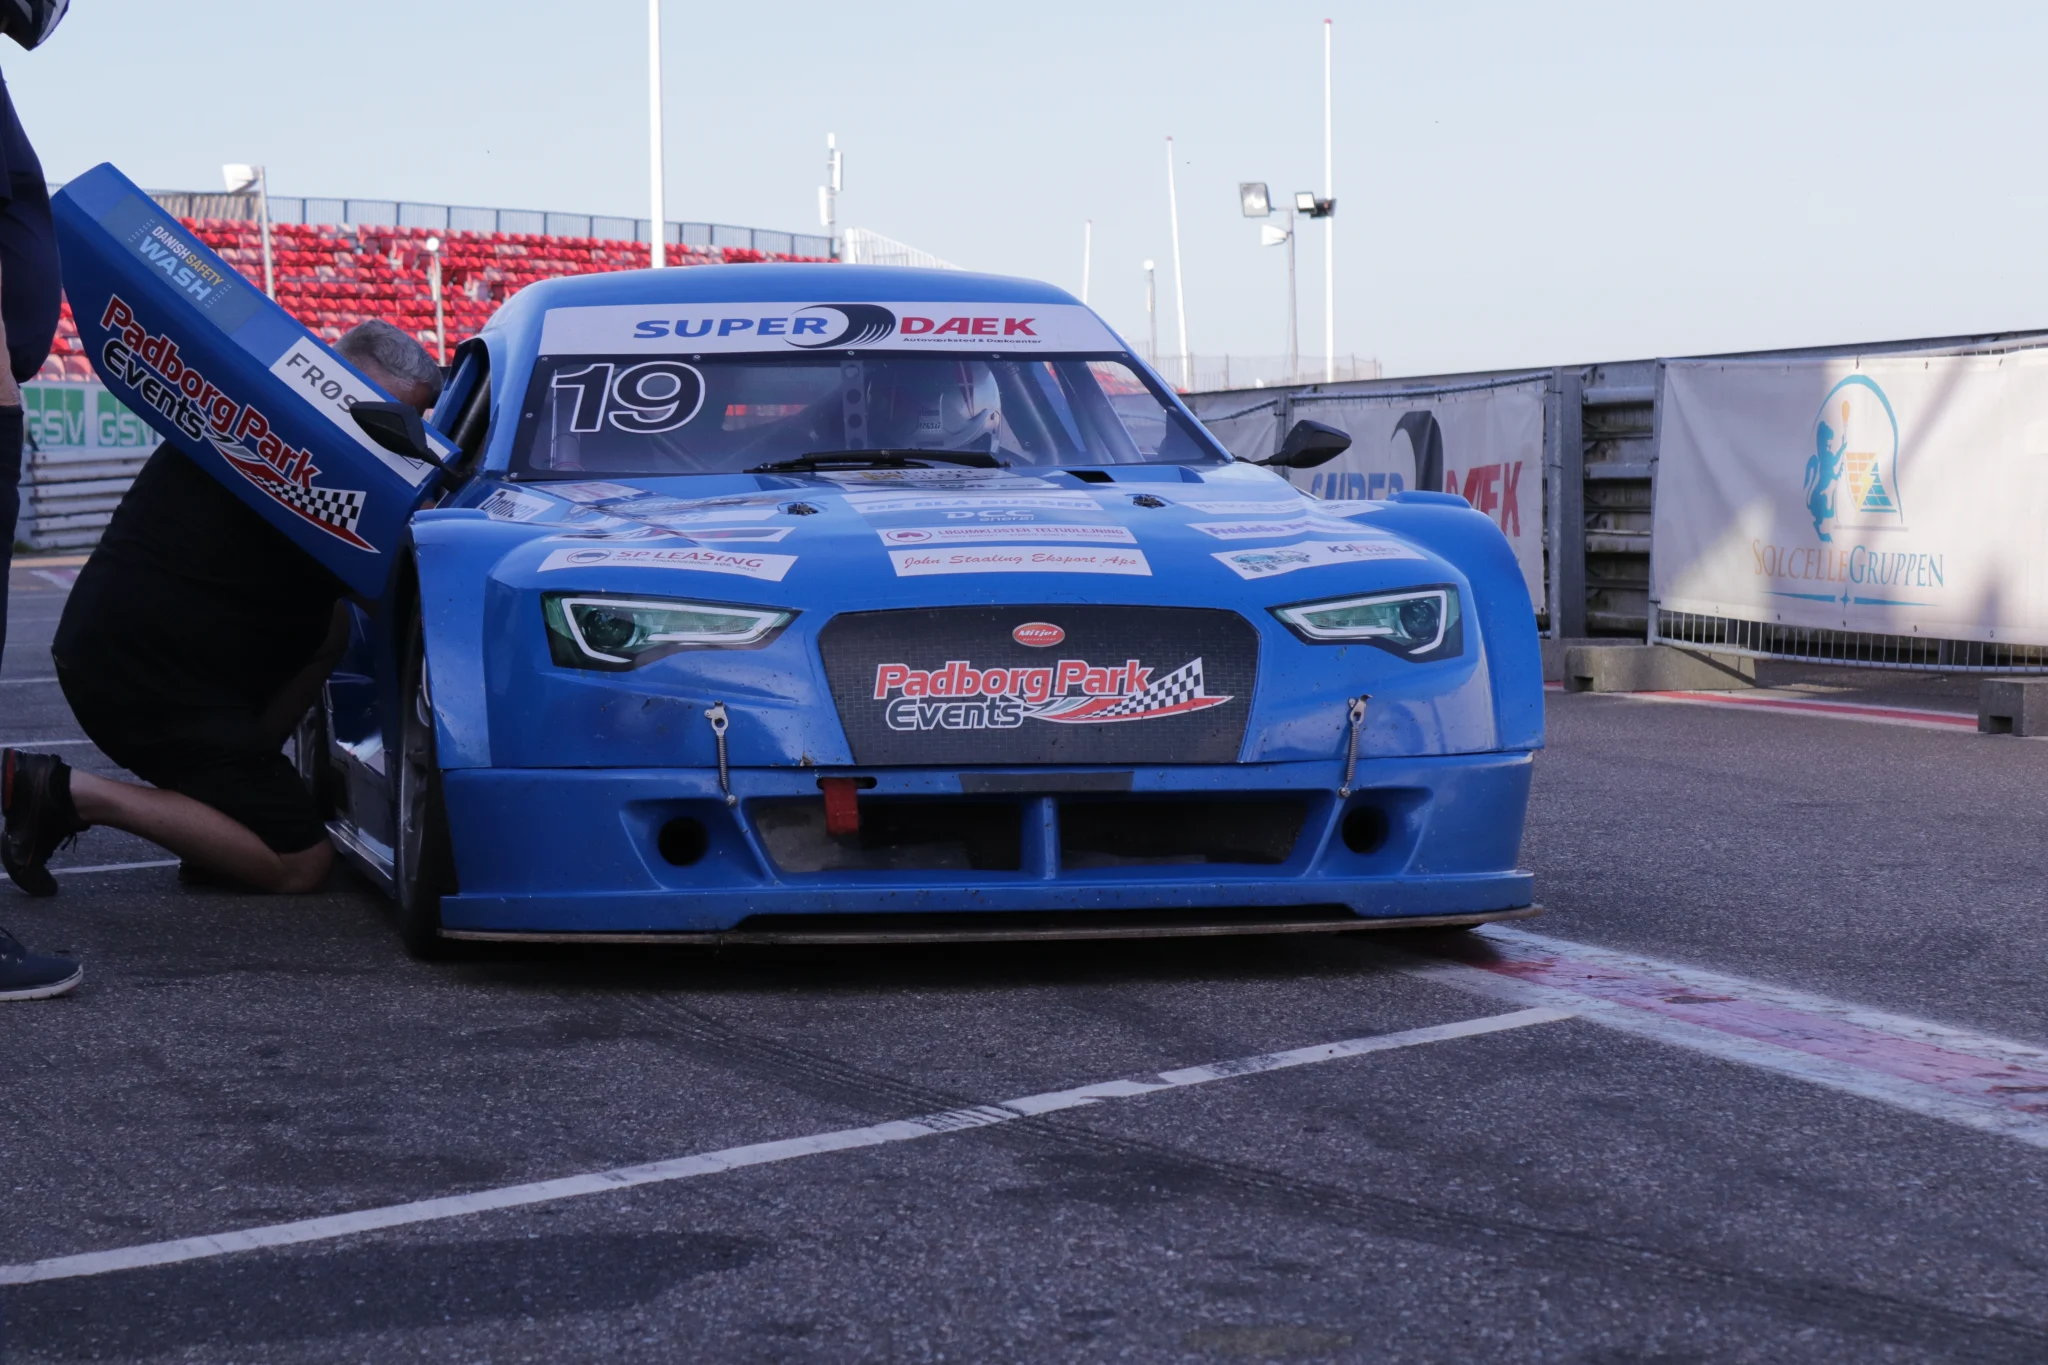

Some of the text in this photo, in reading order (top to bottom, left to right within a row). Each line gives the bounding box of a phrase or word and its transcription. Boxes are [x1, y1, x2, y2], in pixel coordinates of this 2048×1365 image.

[139, 235, 212, 301] WASH
[152, 226, 224, 286] DANISH SAFETY
[633, 317, 828, 339] SUPER
[100, 293, 322, 488] Padborg Park
[102, 338, 208, 441] Events
[551, 361, 705, 433] 19
[940, 509, 1034, 519] DCC
[617, 550, 765, 568] SP LEASING
[904, 553, 1137, 569] John Staaling Eksport Aps
[873, 659, 1154, 702] Padborg Park
[886, 697, 1024, 730] Events
